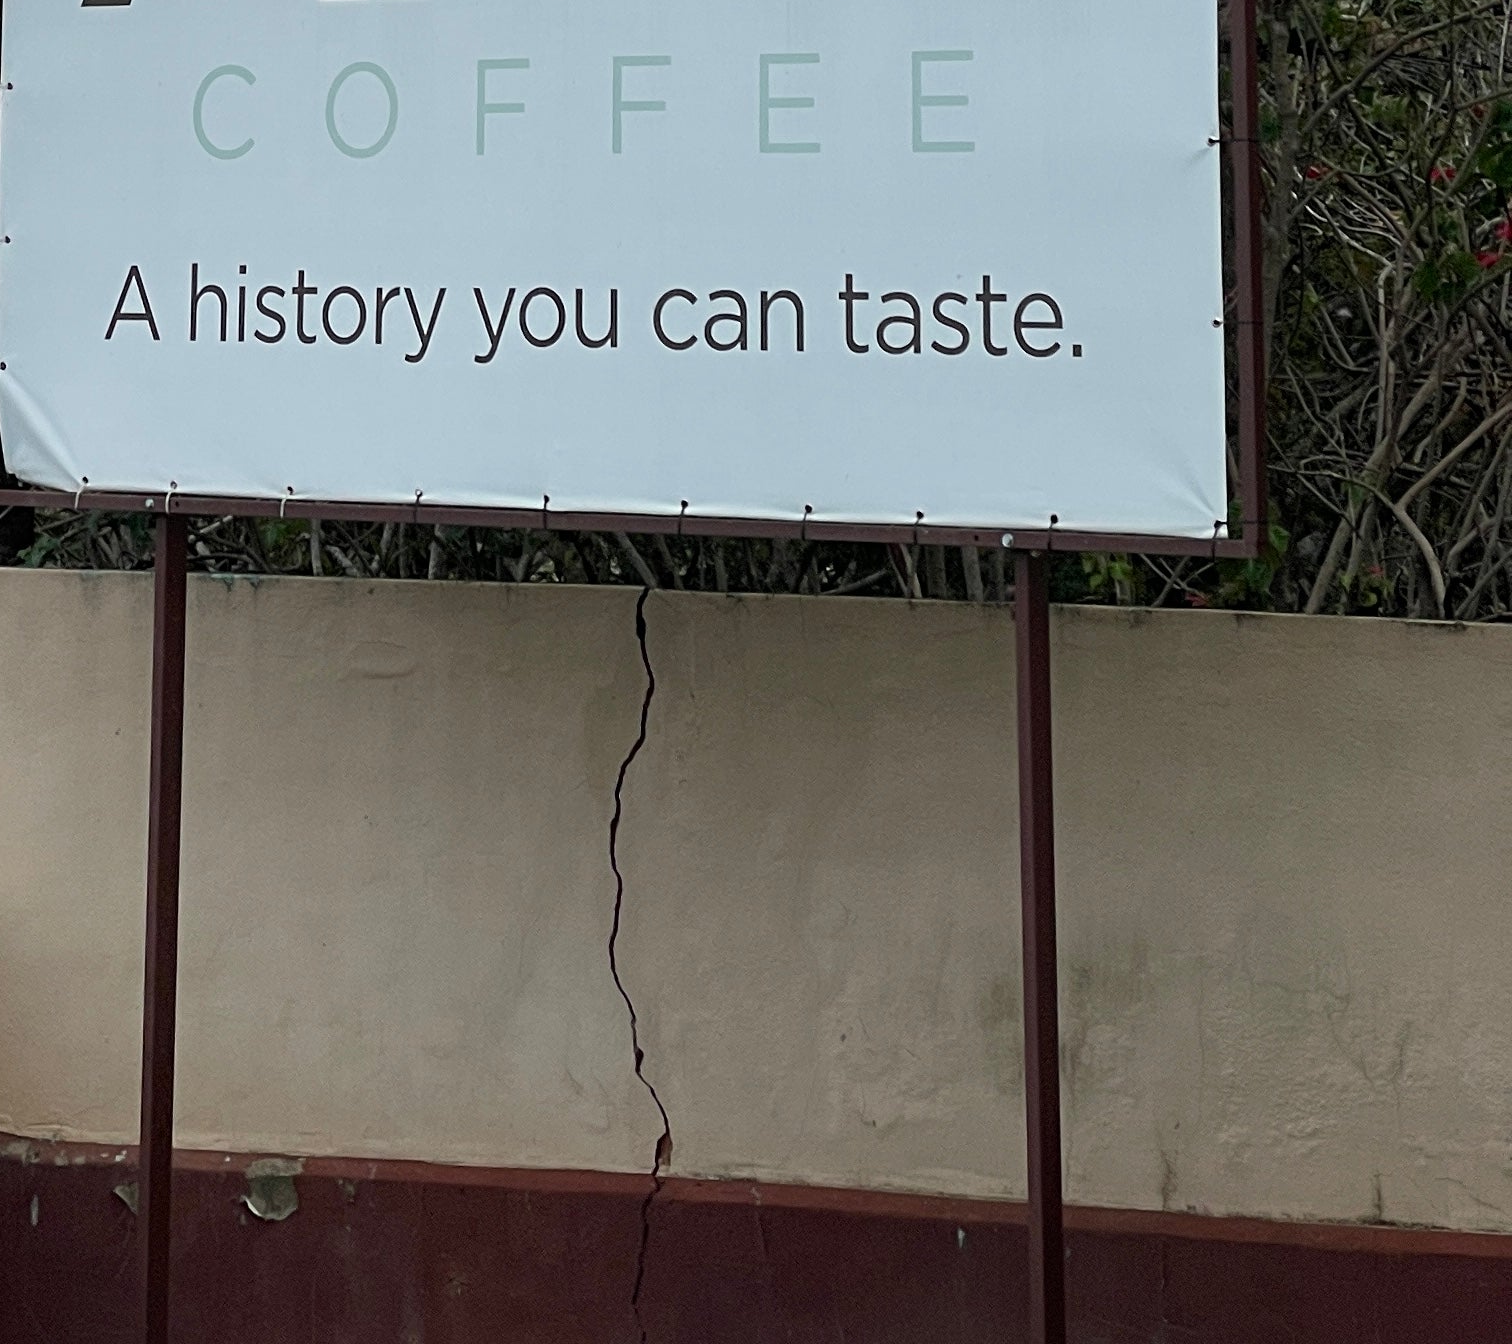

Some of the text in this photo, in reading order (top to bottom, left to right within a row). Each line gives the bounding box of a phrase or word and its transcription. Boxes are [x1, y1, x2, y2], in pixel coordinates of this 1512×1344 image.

[191, 49, 977, 161] COFFEE
[104, 262, 1085, 364] A history you can taste.
